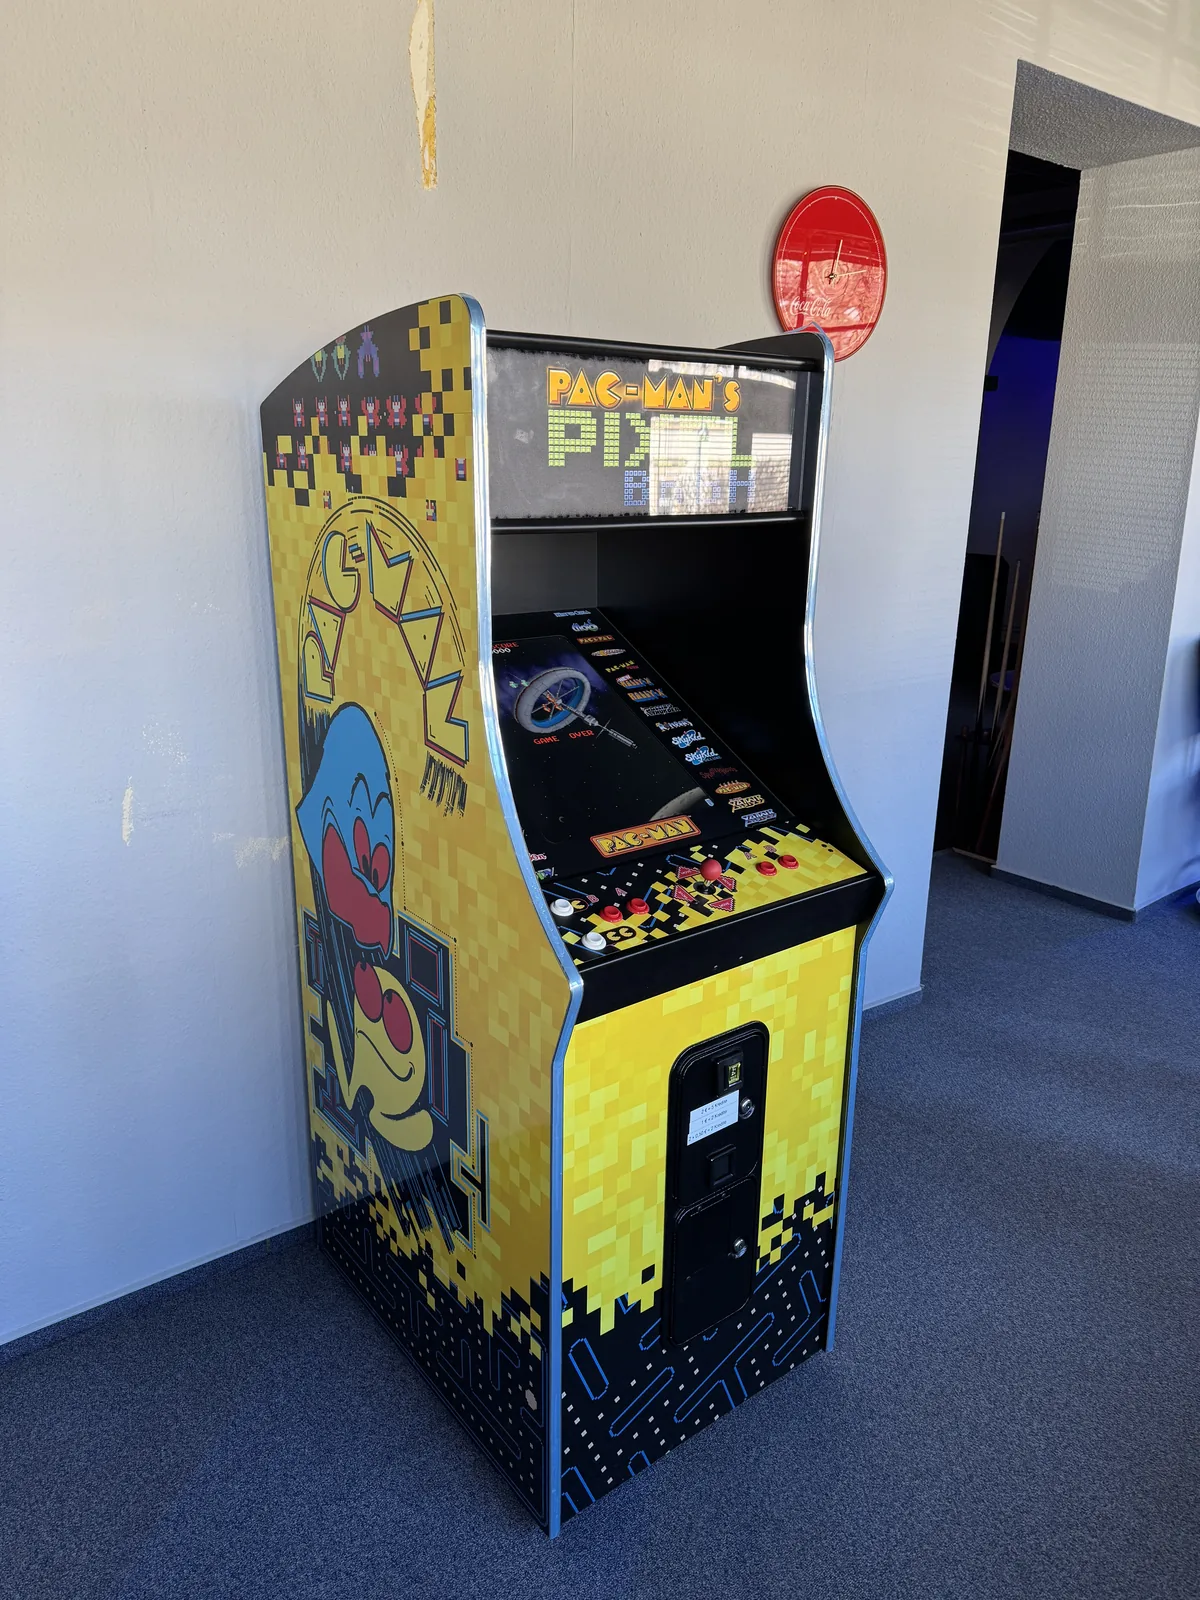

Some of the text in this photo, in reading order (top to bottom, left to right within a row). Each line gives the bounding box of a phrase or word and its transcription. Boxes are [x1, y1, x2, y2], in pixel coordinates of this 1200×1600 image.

[789, 295, 832, 318] Coca-Cola
[547, 365, 742, 414] PAC-MAN'S
[533, 728, 595, 746] GAME OVER
[597, 819, 695, 853] PAC-MAN
